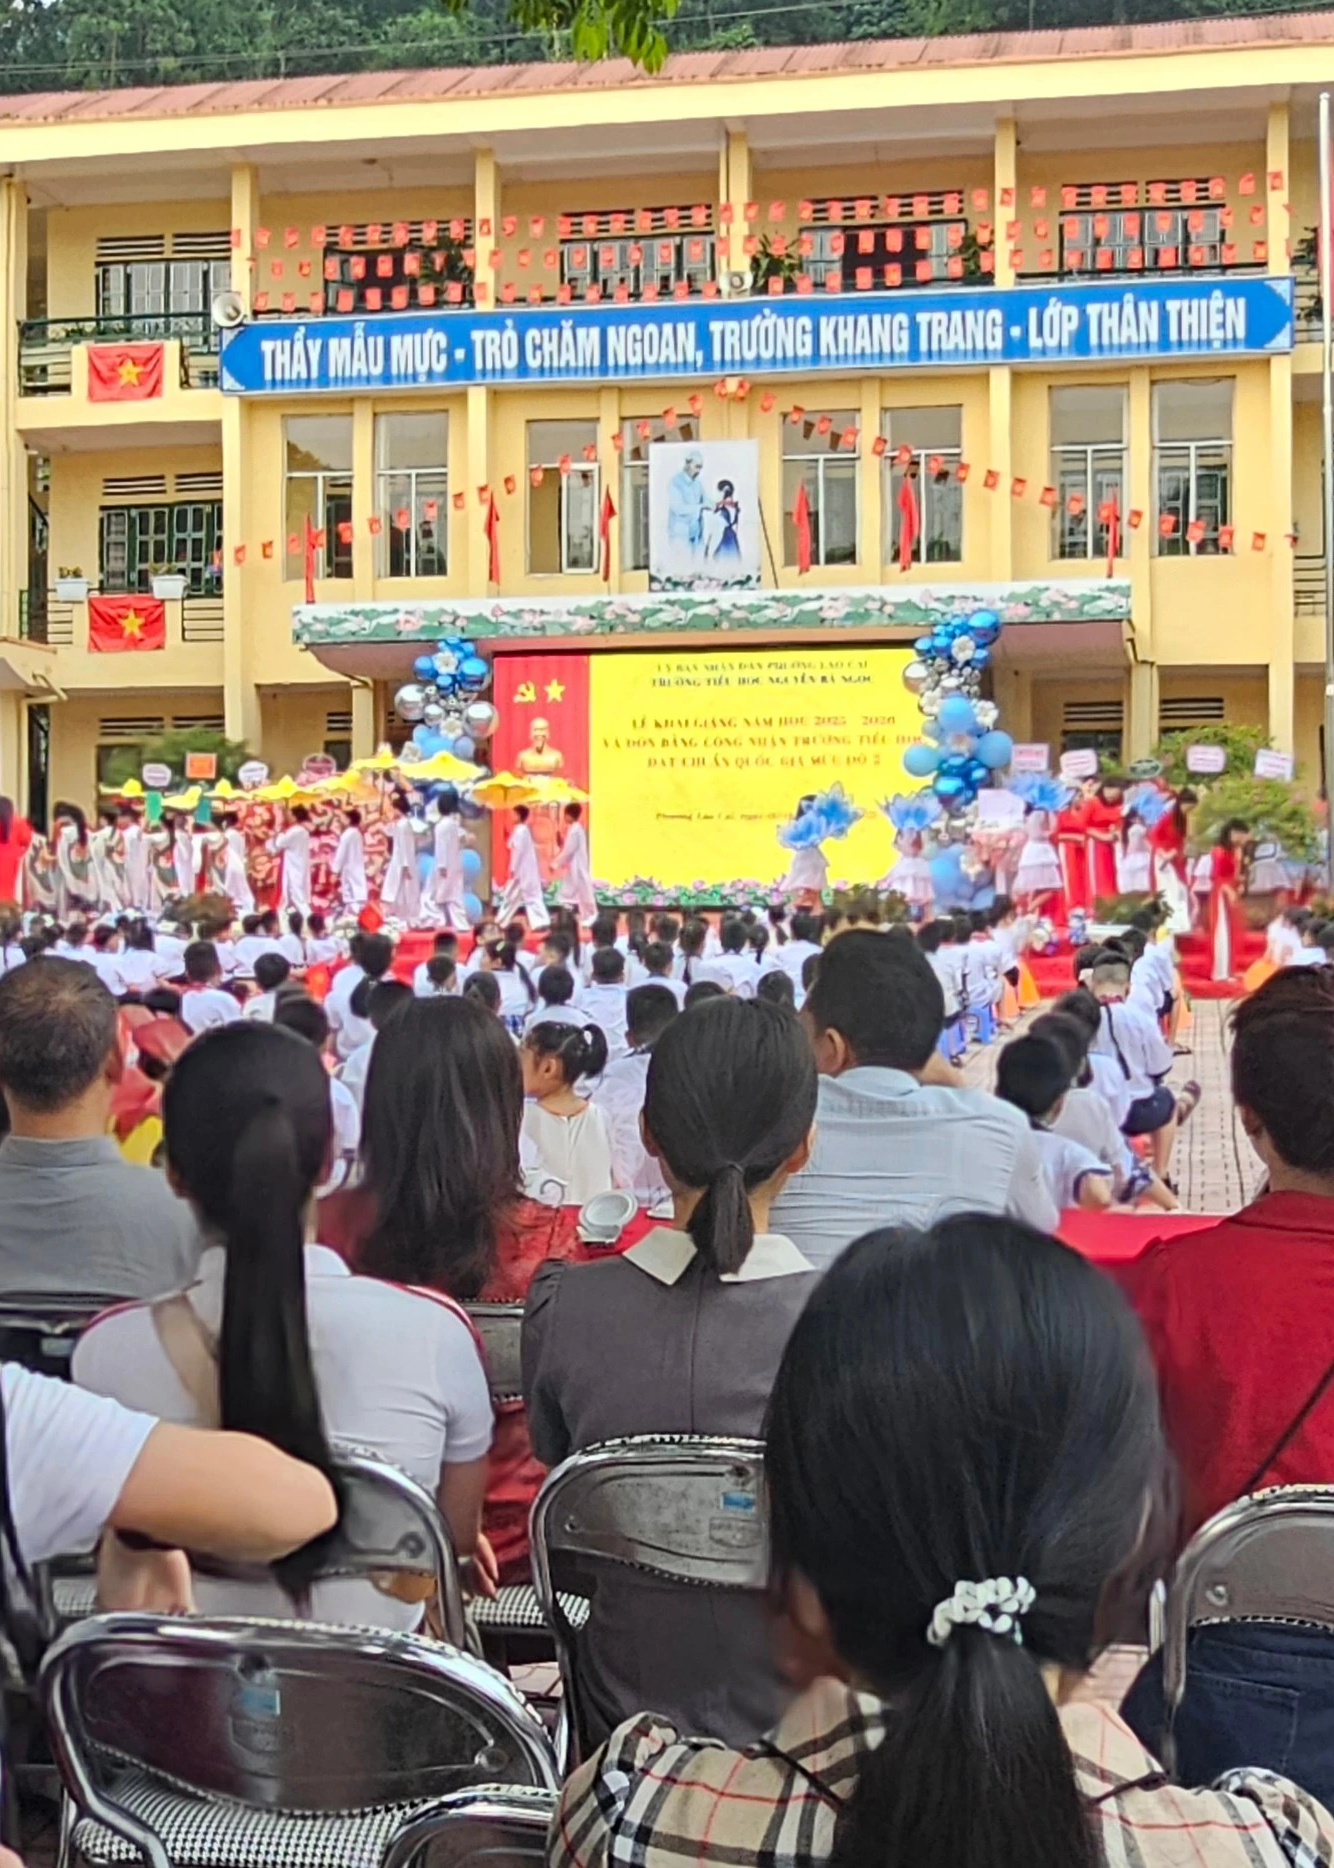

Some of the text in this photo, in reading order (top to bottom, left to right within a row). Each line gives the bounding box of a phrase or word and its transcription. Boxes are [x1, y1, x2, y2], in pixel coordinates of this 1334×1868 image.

[328, 321, 385, 378] MẪU
[389, 328, 448, 381] MỰC
[471, 318, 517, 370] TRÒ
[524, 319, 600, 369] CHĂM
[607, 321, 704, 369] NGOAN,
[709, 308, 812, 362] TRƯỜNG
[819, 312, 909, 357] KHANG
[916, 309, 1003, 351] TRANG
[1028, 296, 1079, 348] LỚP
[1086, 293, 1159, 345] THÂN
[1166, 289, 1246, 348] THIỆN
